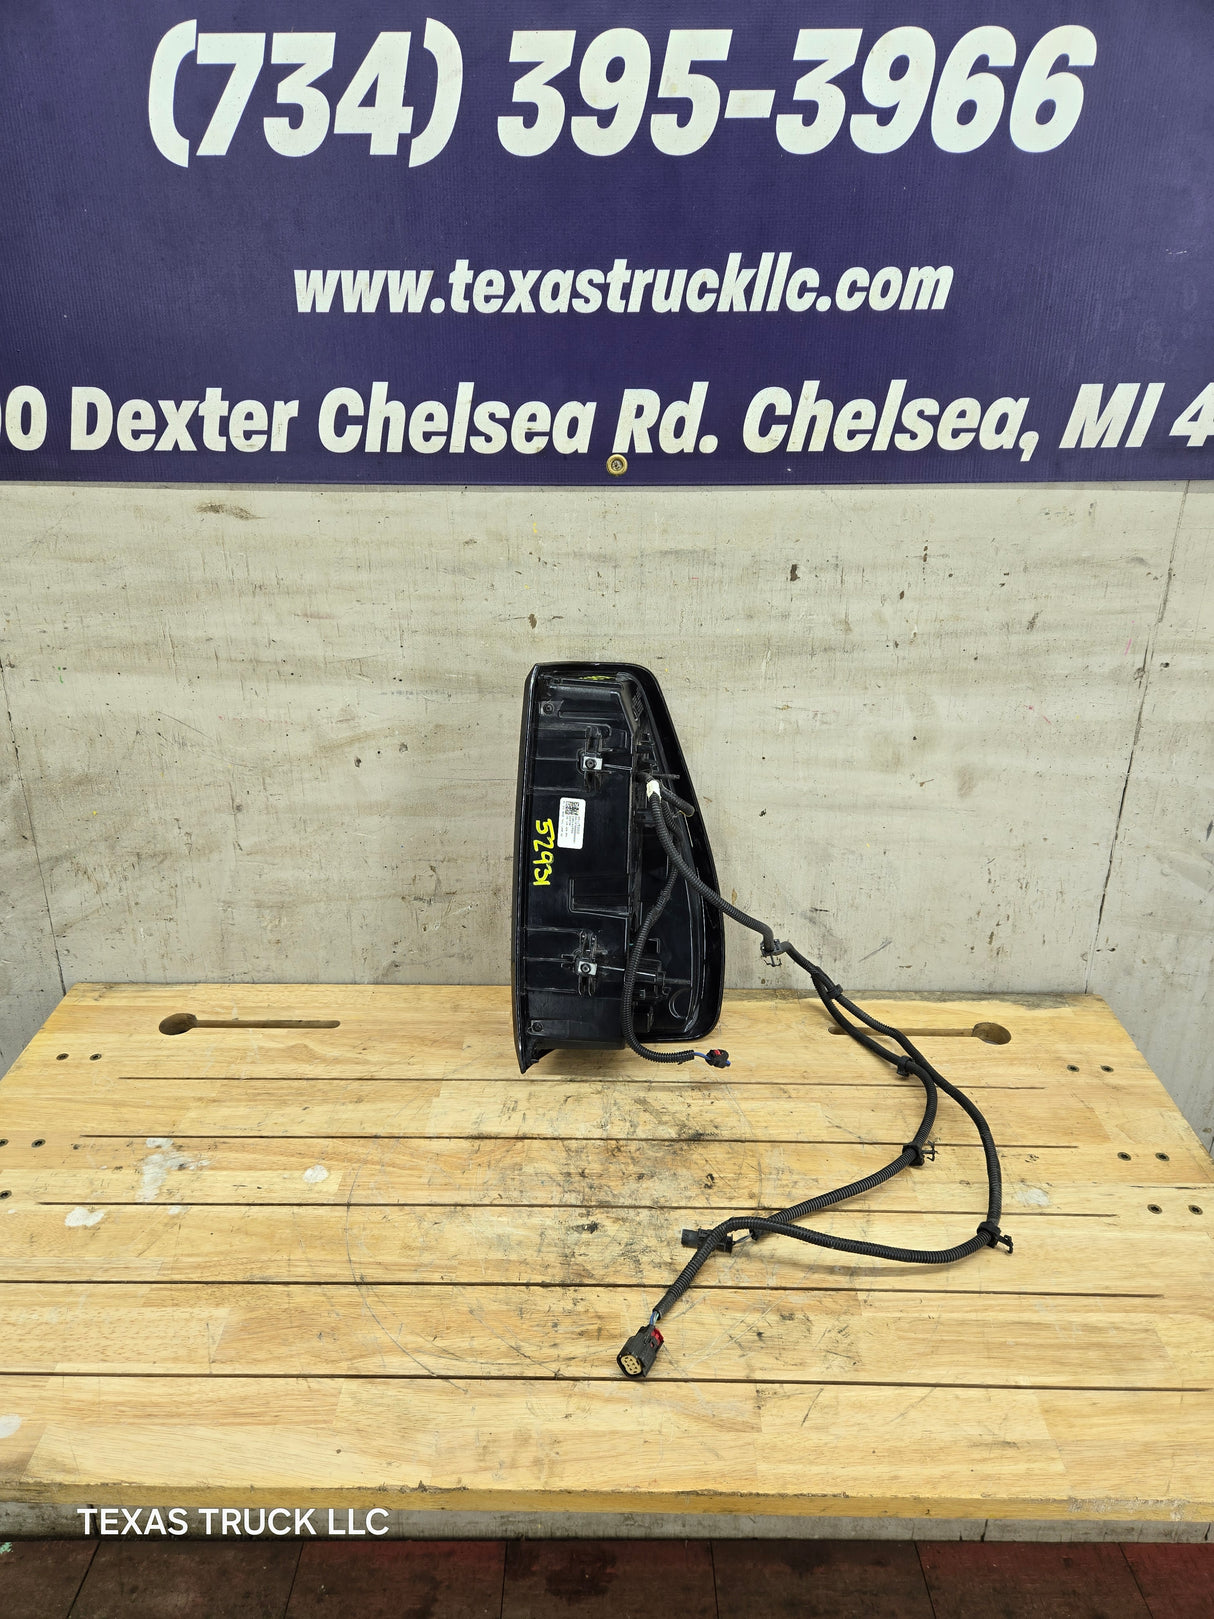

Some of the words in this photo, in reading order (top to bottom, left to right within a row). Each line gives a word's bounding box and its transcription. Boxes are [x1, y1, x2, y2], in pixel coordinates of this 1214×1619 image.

[148, 17, 464, 168] (734)
[497, 24, 1098, 157] 395-3966
[293, 251, 954, 314] www.texastruckllc.com
[0, 385, 48, 451] 0
[70, 386, 300, 453] Dexter
[318, 380, 597, 455] Chelsea
[611, 381, 719, 455] Rd.
[742, 379, 1040, 462] Chelsea,
[1058, 382, 1166, 449] MI
[532, 818, 555, 886] 52931
